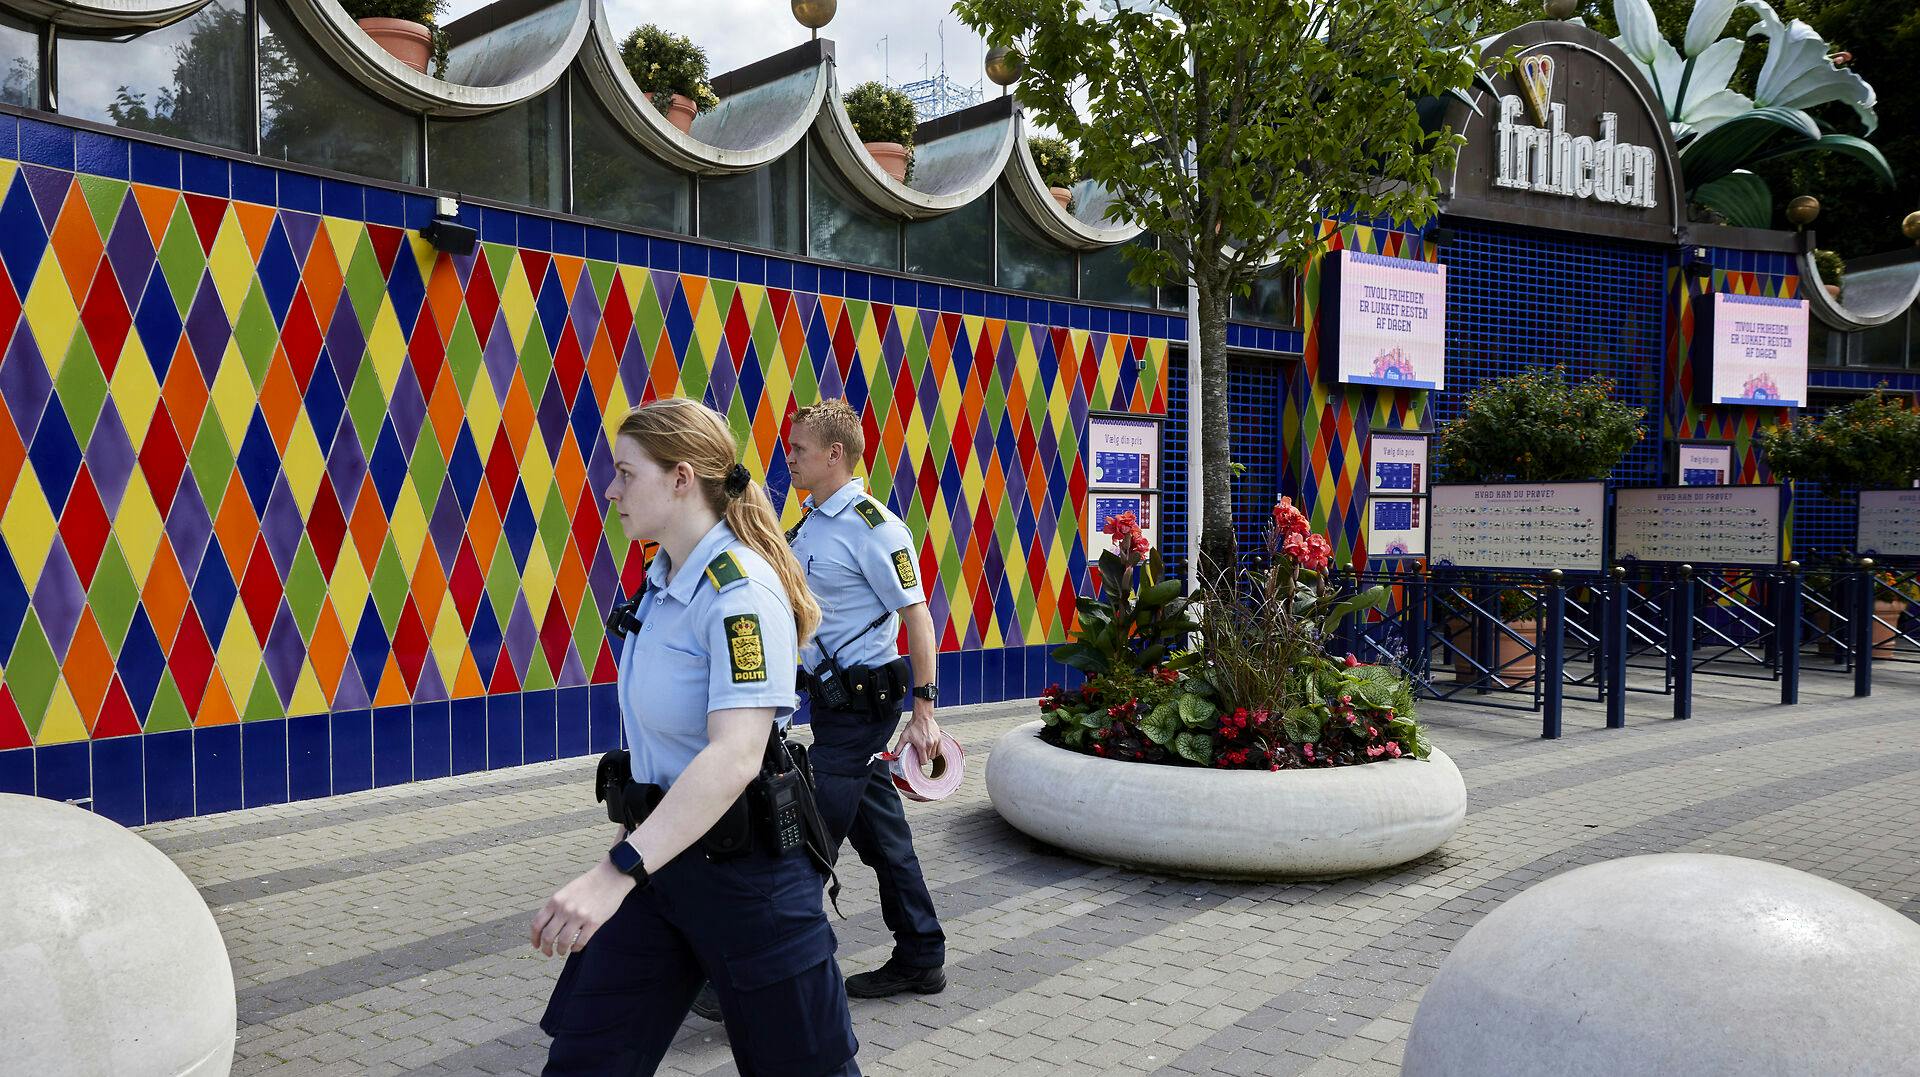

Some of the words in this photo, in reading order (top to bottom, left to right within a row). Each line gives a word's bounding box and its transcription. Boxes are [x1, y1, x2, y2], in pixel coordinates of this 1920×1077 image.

[1496, 94, 1657, 208] friheden
[1364, 286, 1387, 299] TIVOLI
[1389, 289, 1424, 304] FRIHEDEN
[1360, 301, 1370, 312] ER
[1371, 302, 1399, 316] LUKKET
[1401, 305, 1428, 319] RESTEN
[1377, 317, 1386, 329] AF
[1387, 319, 1412, 332] DAGEN
[1735, 321, 1756, 332] TIVOLI
[1757, 323, 1788, 335] FRIHEDEN
[1731, 334, 1740, 344] ER
[1741, 334, 1766, 346] LUKKET
[1767, 336, 1792, 347] RESTEN
[1746, 347, 1754, 357] AF
[1755, 348, 1777, 359] DAGEN
[1121, 435, 1130, 445] din
[1131, 436, 1142, 447] pris
[1474, 491, 1494, 499] HVAD
[1495, 491, 1511, 499] KAN
[1513, 490, 1524, 498] DU
[1526, 490, 1555, 498] PRØVE?
[735, 671, 765, 681] POLITI
